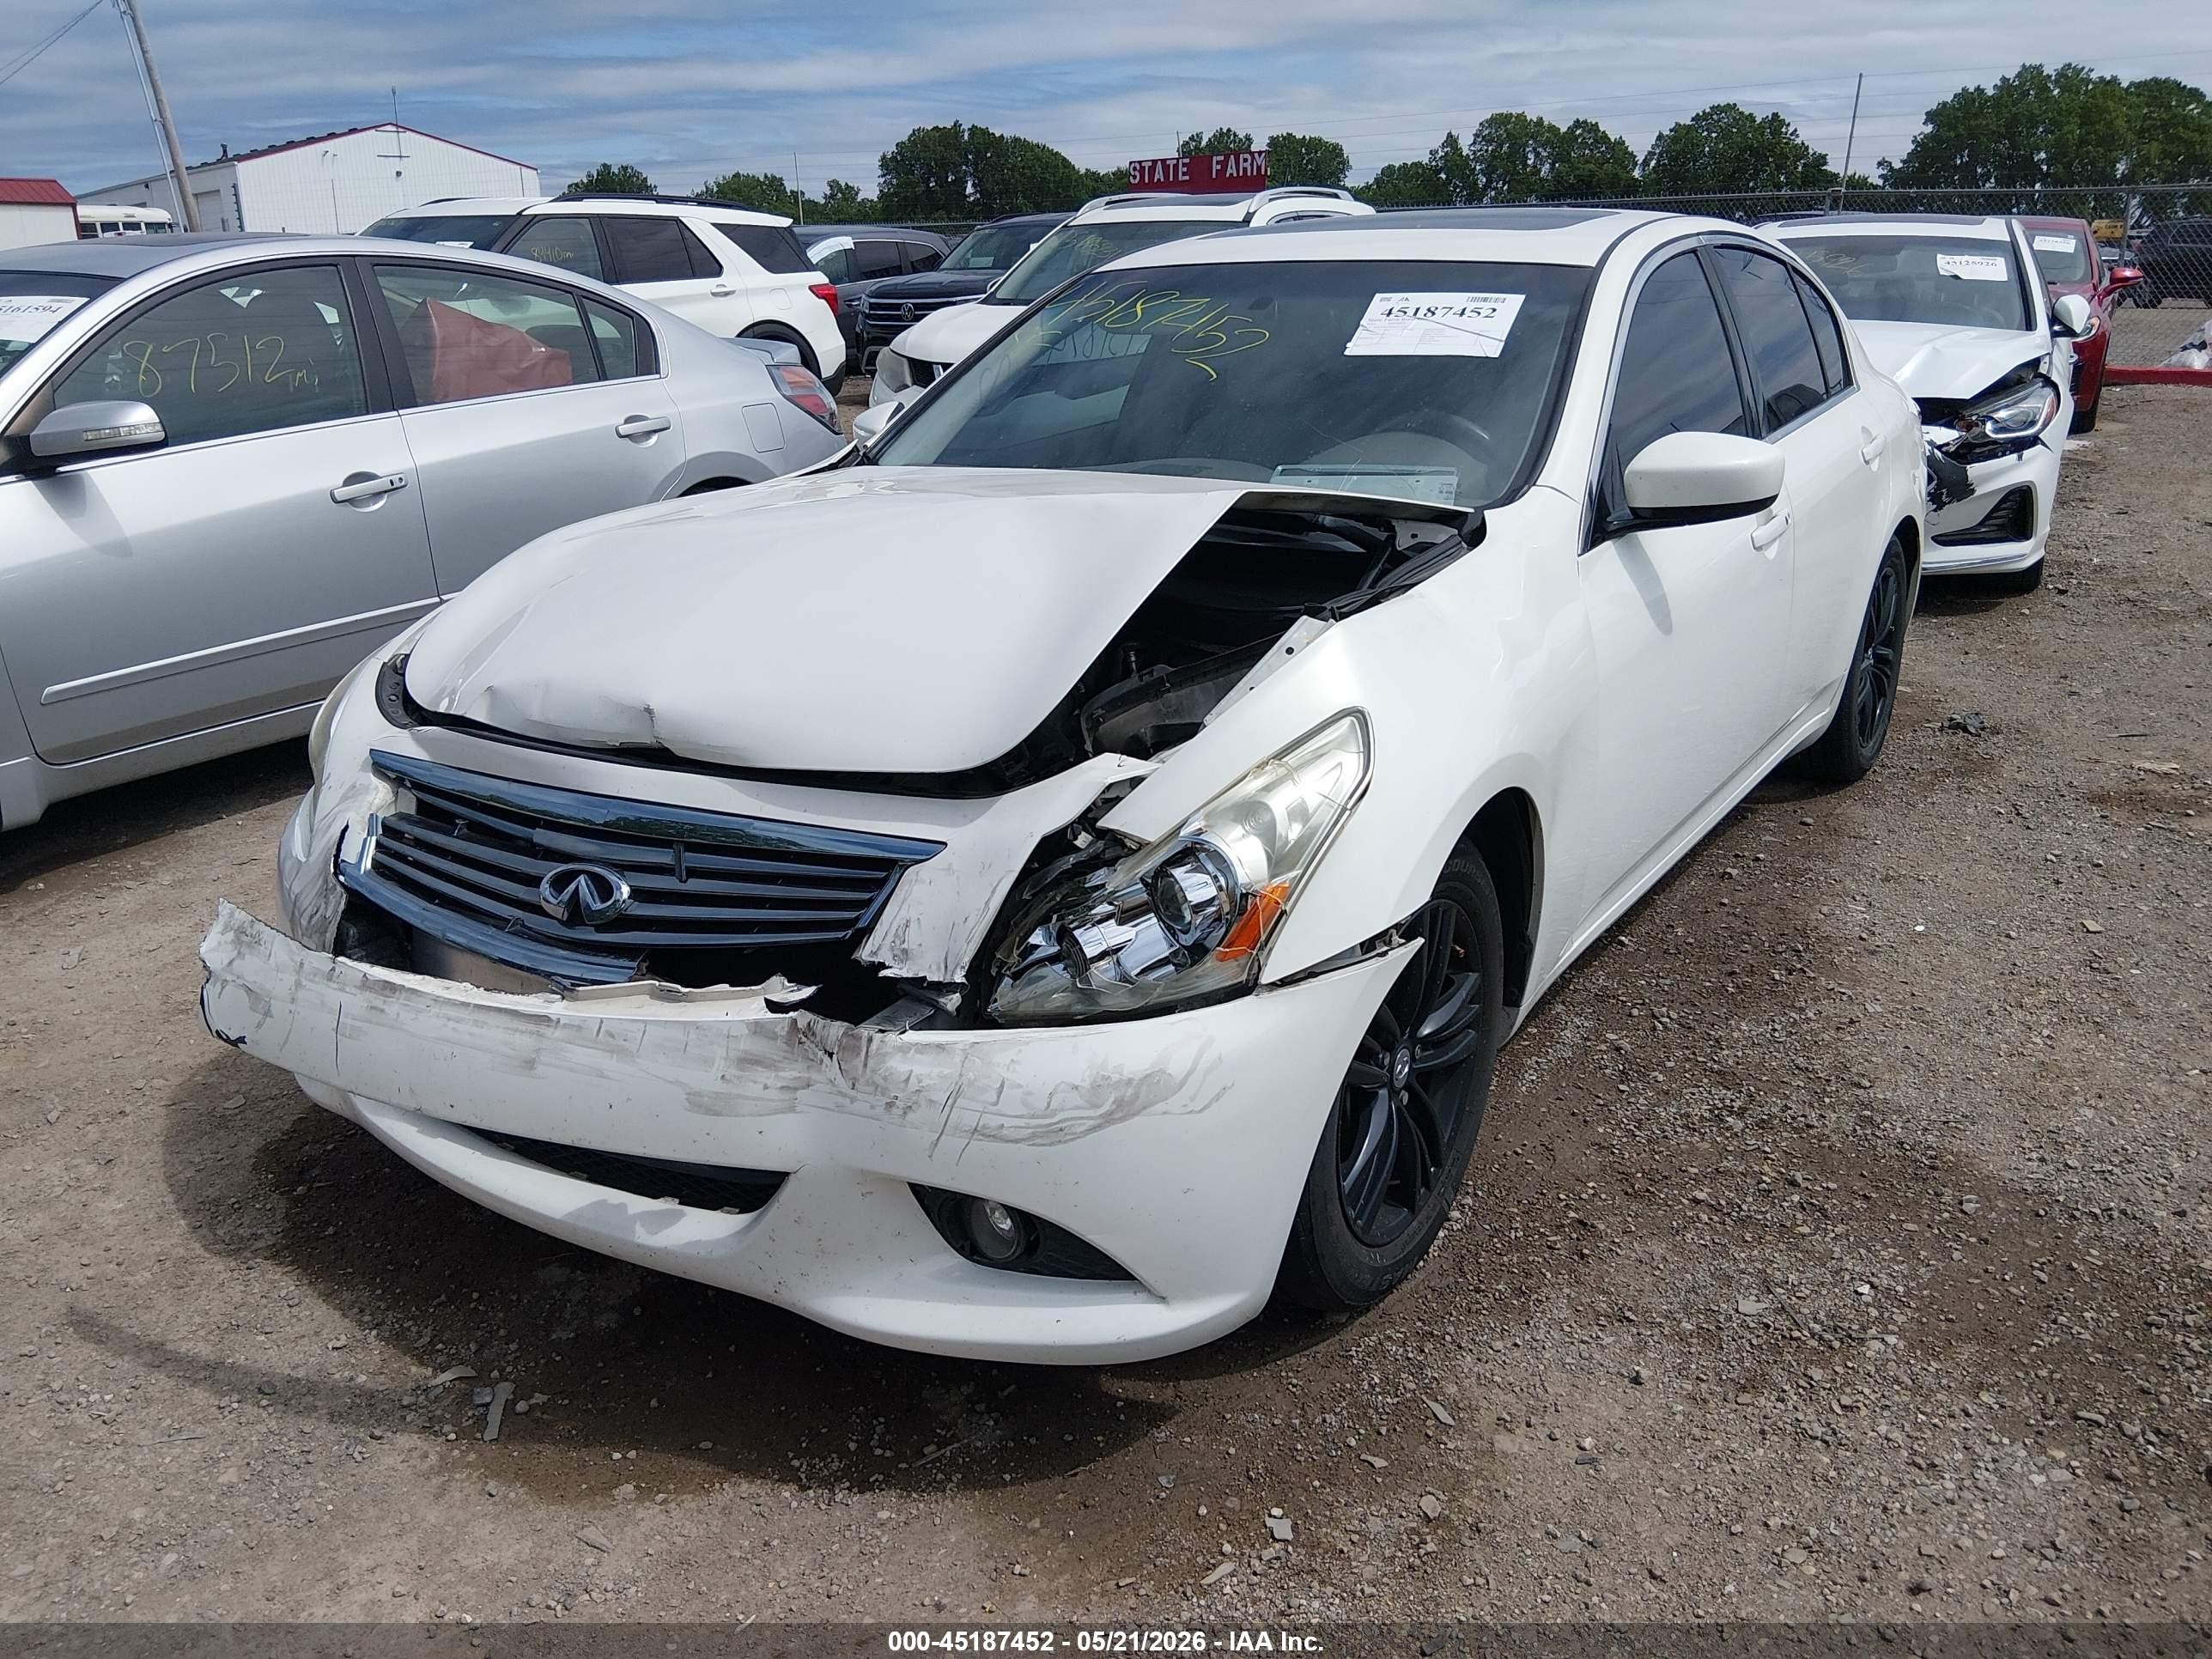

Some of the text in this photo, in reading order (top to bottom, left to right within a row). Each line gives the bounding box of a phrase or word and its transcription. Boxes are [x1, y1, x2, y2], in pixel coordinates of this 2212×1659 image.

[1129, 152, 1266, 184] STATE FARM
[1380, 306, 1498, 319] 45187452
[123, 332, 295, 398] 87512
